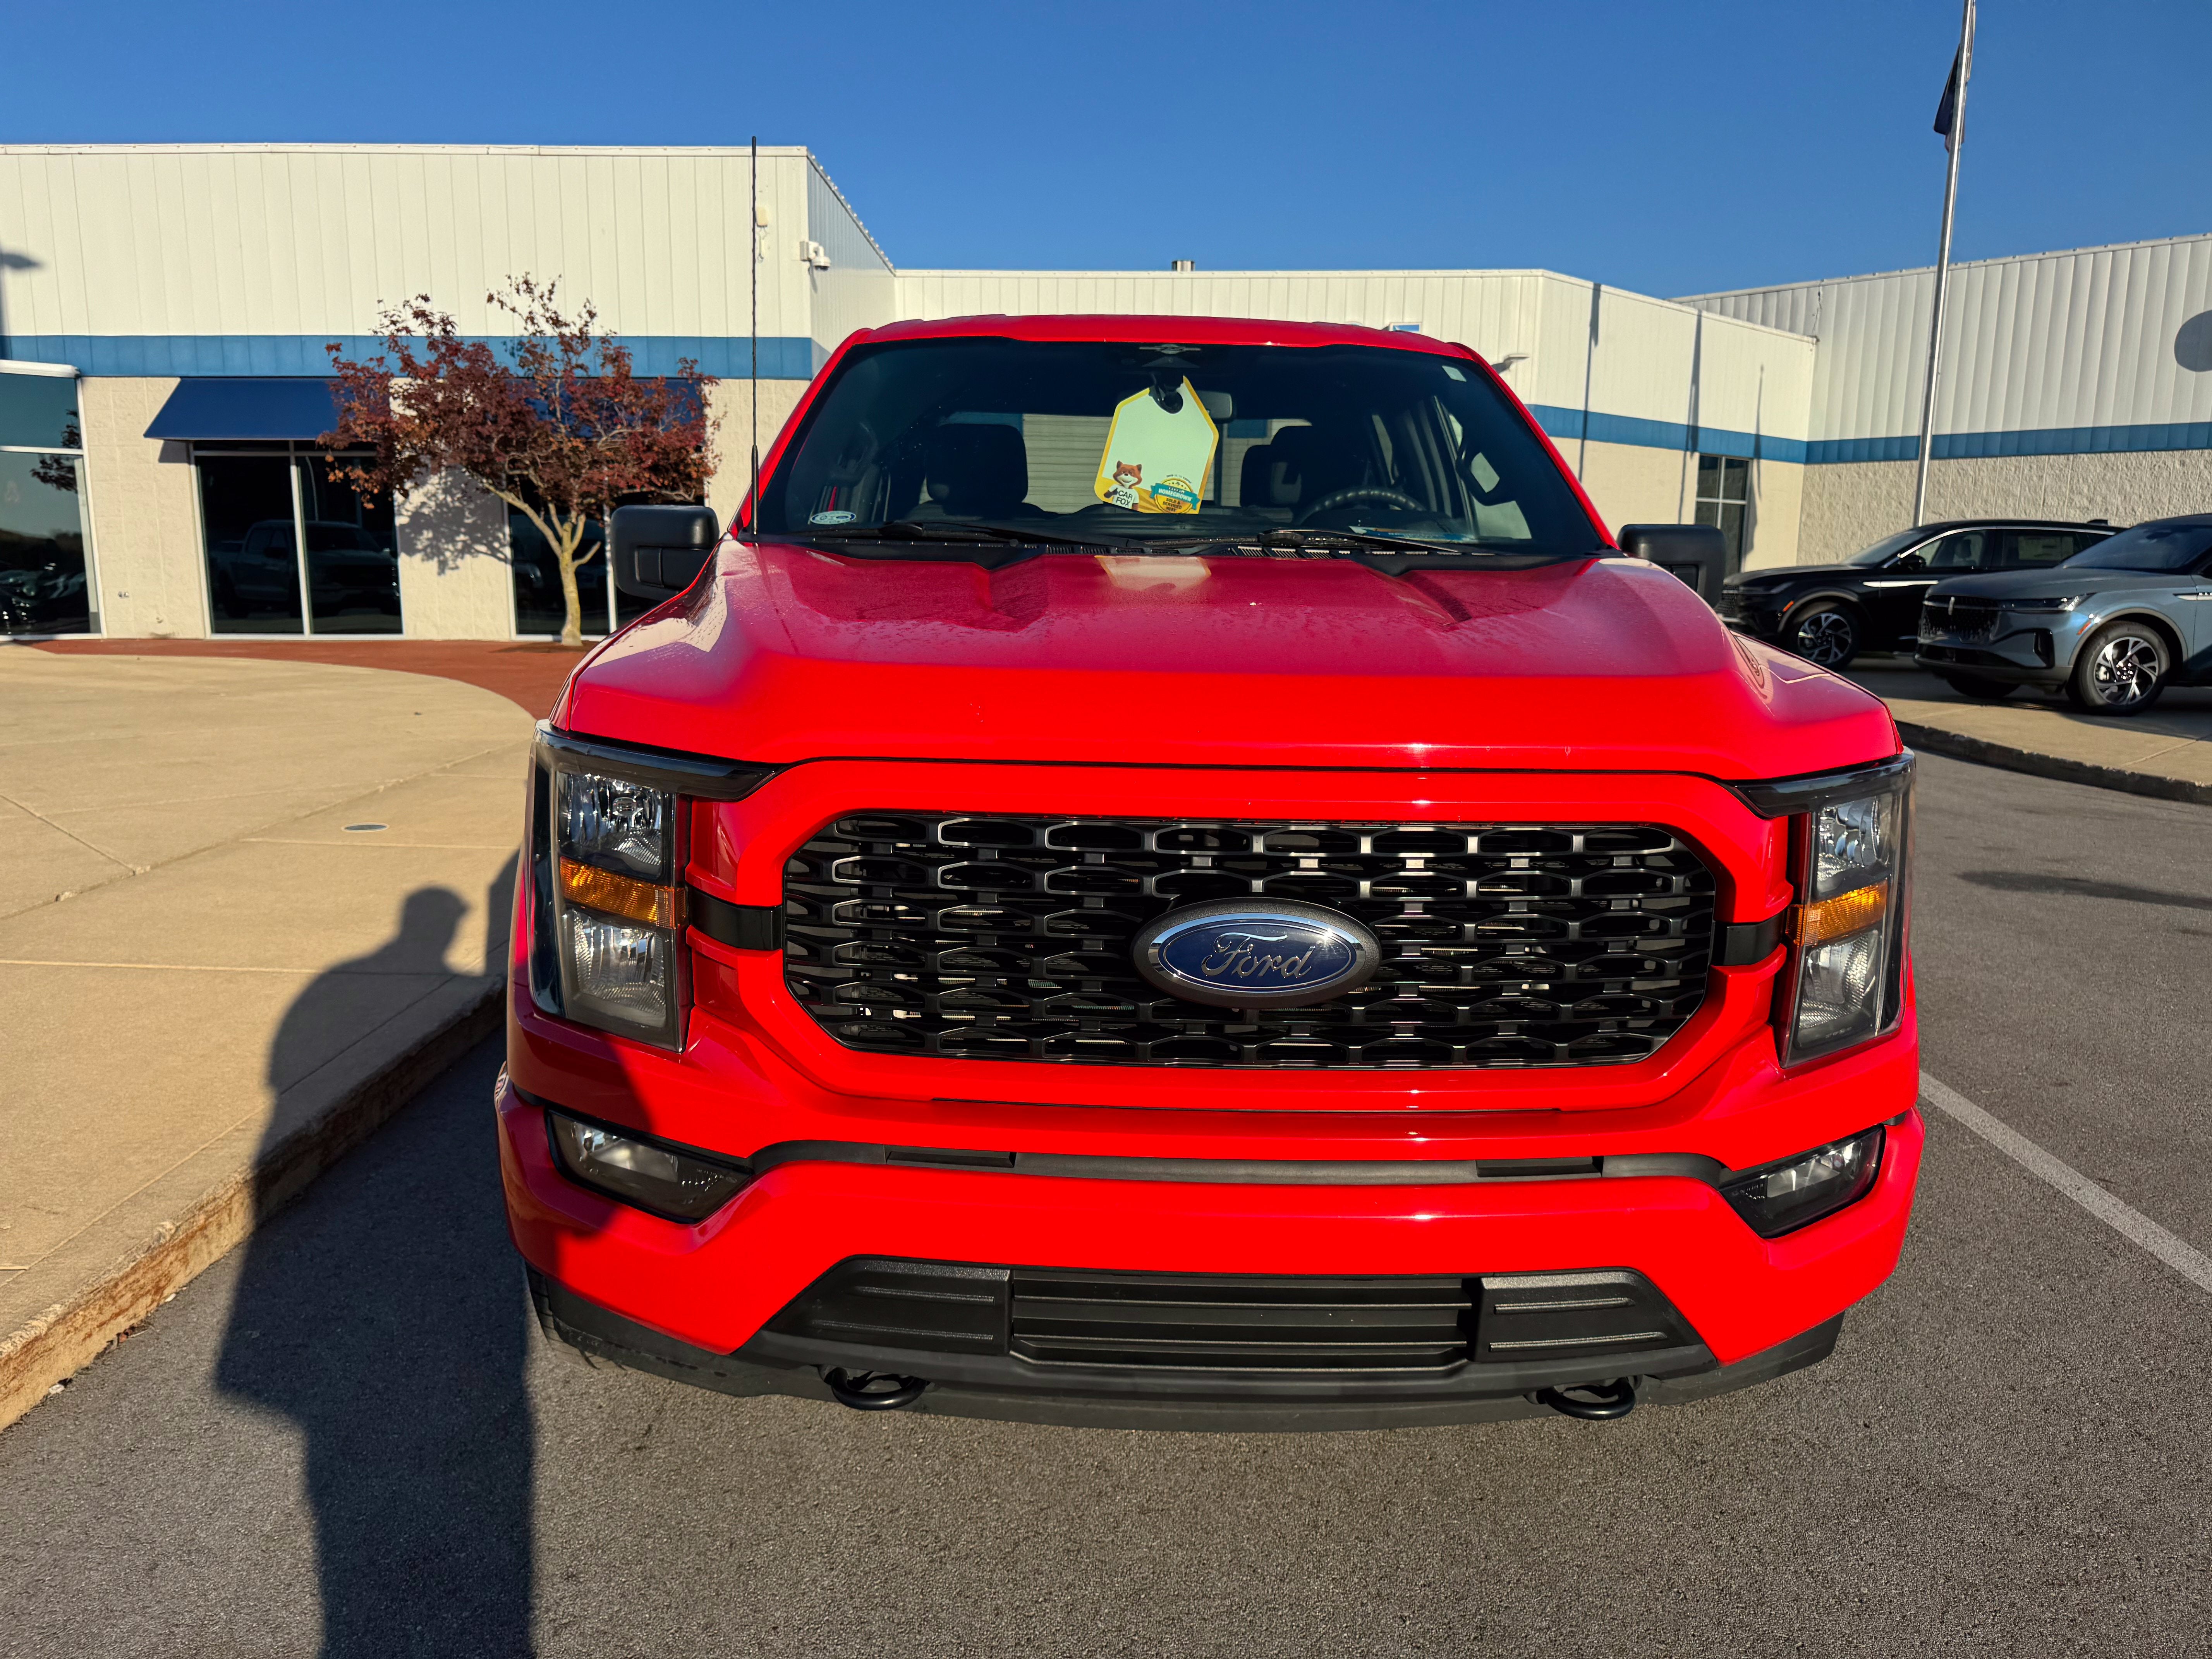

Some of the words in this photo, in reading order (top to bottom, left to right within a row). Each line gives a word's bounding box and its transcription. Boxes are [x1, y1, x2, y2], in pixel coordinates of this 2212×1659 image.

[1118, 490, 1133, 501] CAR
[1158, 488, 1192, 501] HOMEGROWN
[1116, 497, 1130, 507] FOX
[1201, 932, 1315, 974] Ford
